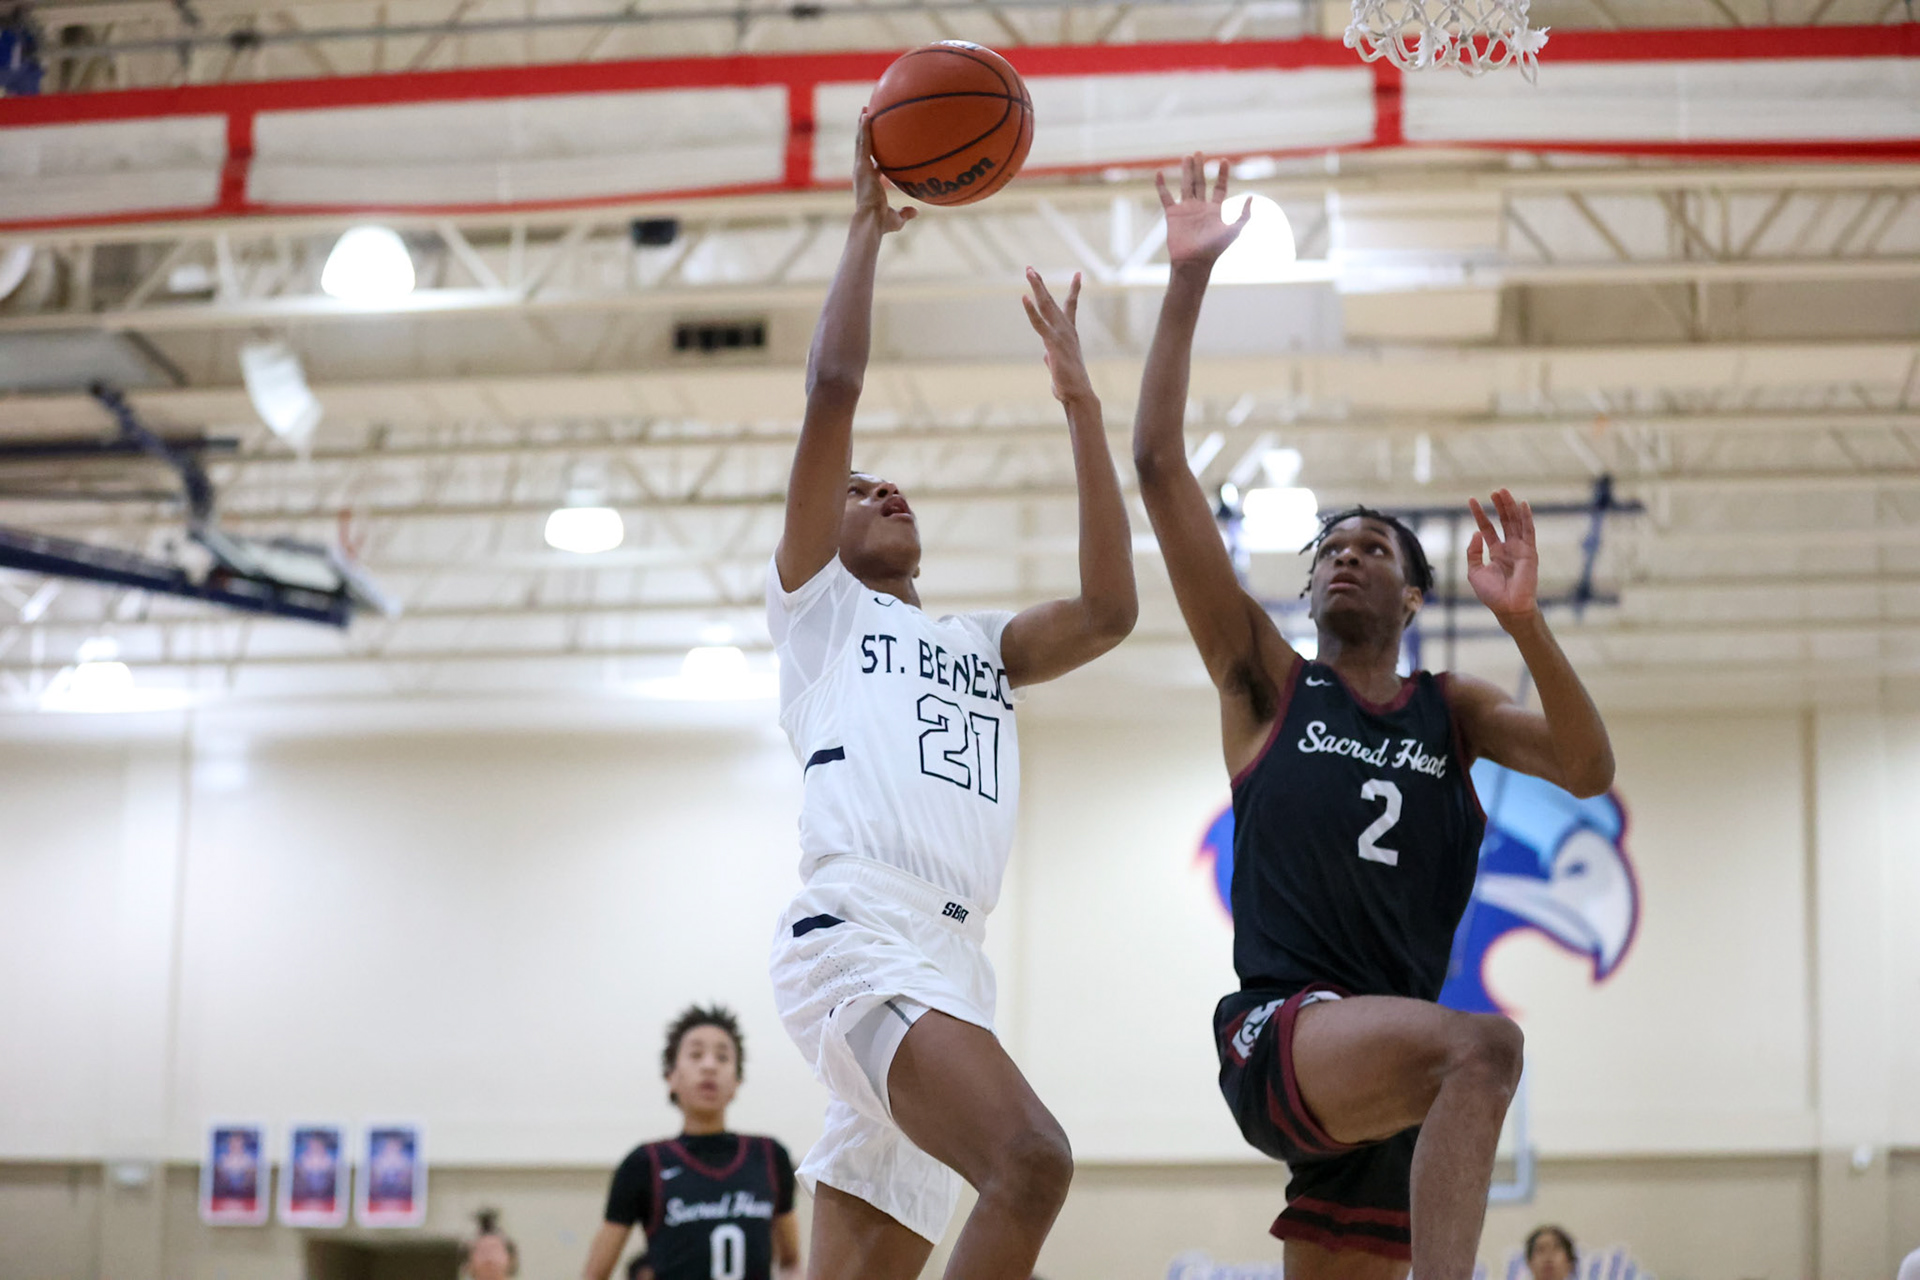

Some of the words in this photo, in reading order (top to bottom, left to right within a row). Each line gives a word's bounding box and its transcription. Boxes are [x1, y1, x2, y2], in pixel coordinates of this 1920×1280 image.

[861, 634, 905, 674] ST.
[916, 693, 999, 804] 21
[1298, 720, 1390, 768] Sacred
[1391, 738, 1448, 779] Heat
[1358, 778, 1403, 868] 2
[941, 901, 969, 924] SBA
